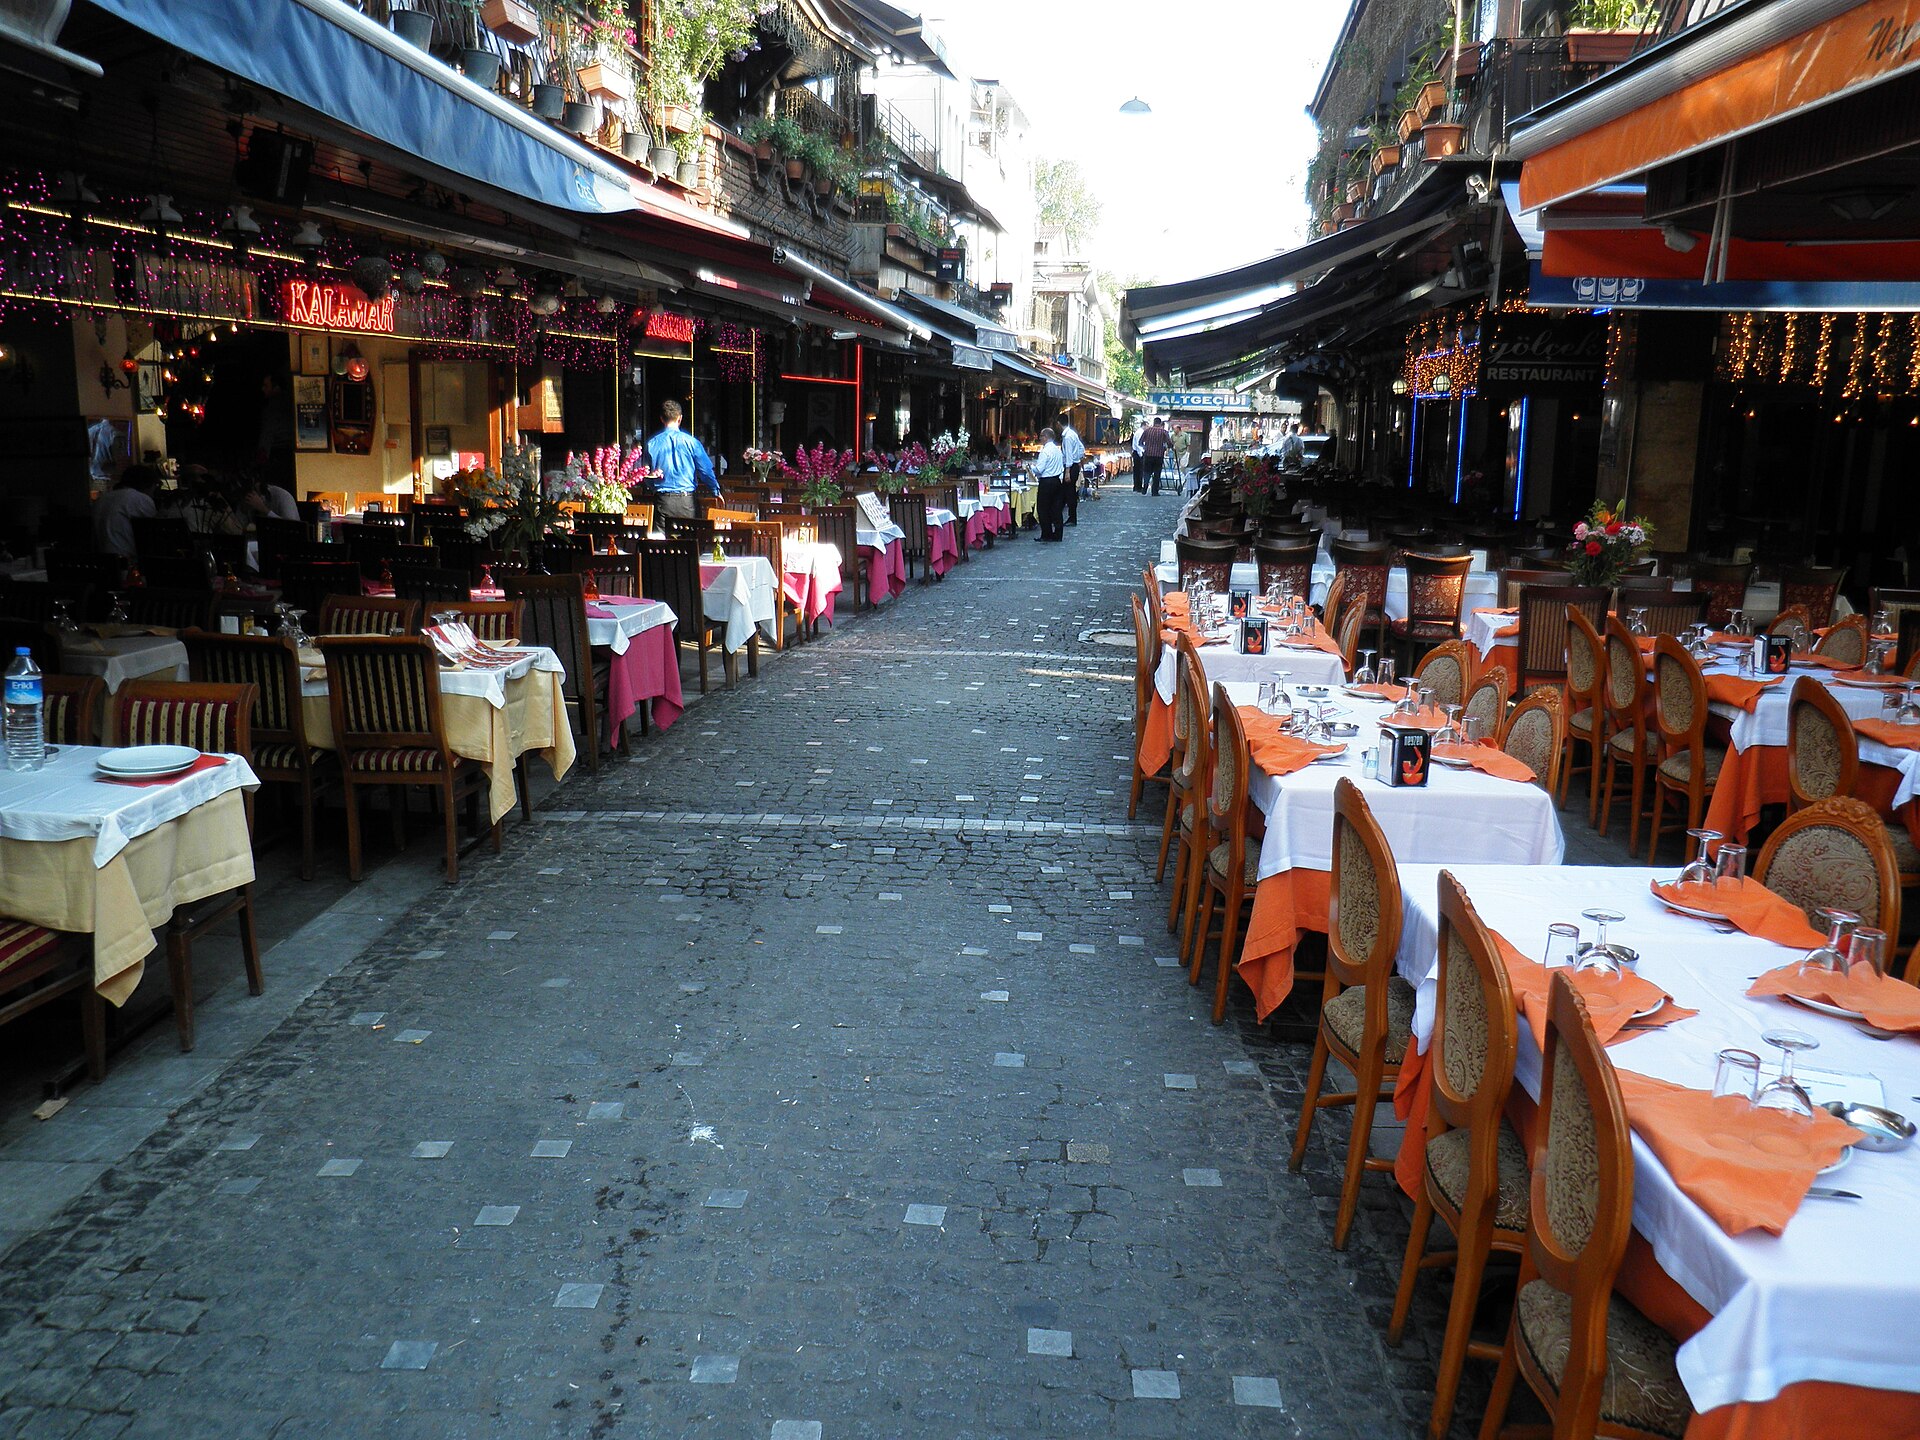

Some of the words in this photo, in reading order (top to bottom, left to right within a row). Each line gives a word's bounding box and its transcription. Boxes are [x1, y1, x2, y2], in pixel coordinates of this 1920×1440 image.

[290, 282, 394, 332] KALAMAR
[1487, 368, 1597, 381] RESTAURANT
[1159, 395, 1246, 407] ALTGEÇİDİ
